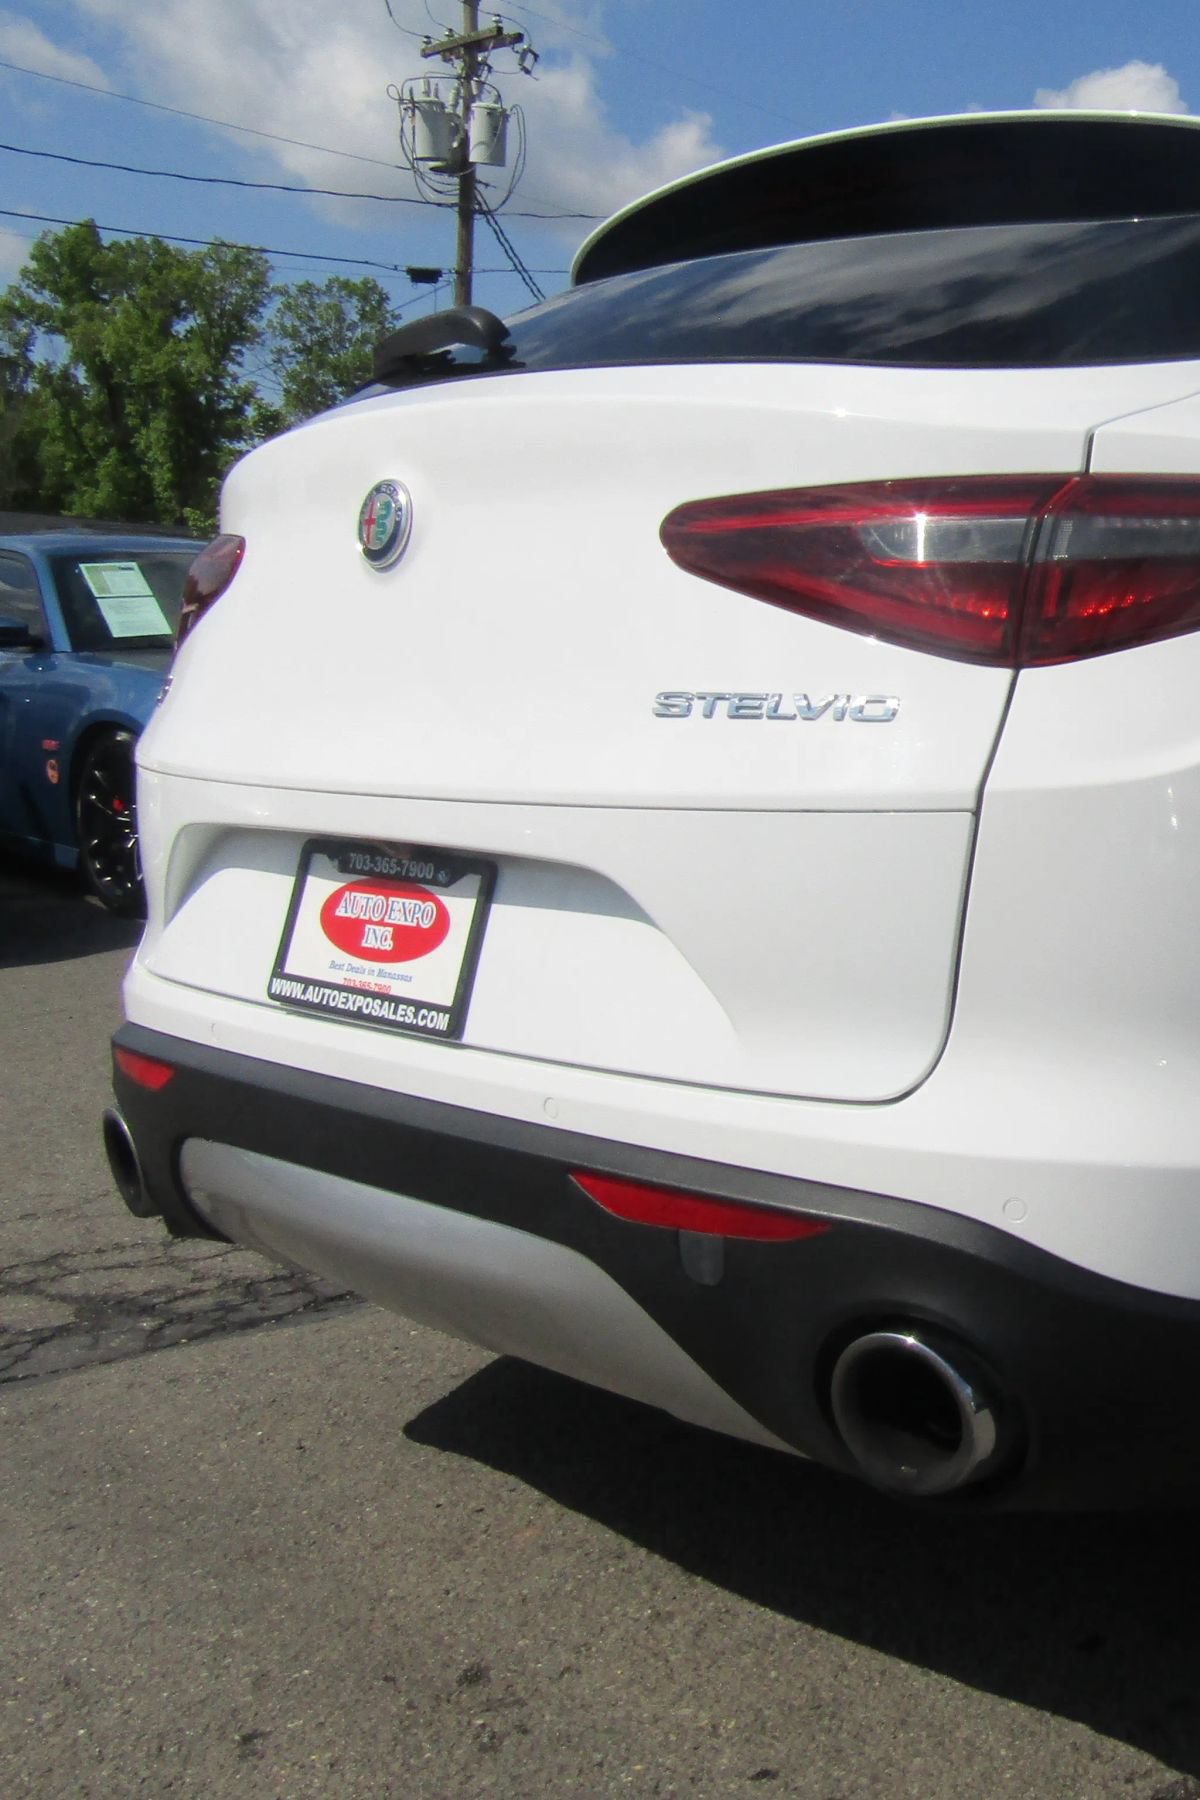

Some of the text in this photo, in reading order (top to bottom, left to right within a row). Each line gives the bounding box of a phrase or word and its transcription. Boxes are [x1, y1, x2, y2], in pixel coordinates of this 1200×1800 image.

[652, 691, 900, 723] STELVIO
[349, 853, 434, 880] 703-365-7900
[336, 892, 436, 928] AUTO EXPO
[361, 925, 393, 950] INC.
[329, 960, 345, 971] Best
[346, 963, 366, 975] Deals
[367, 967, 376, 976] in
[271, 977, 450, 1032] WWW.AUTOEXPOSALES.COM
